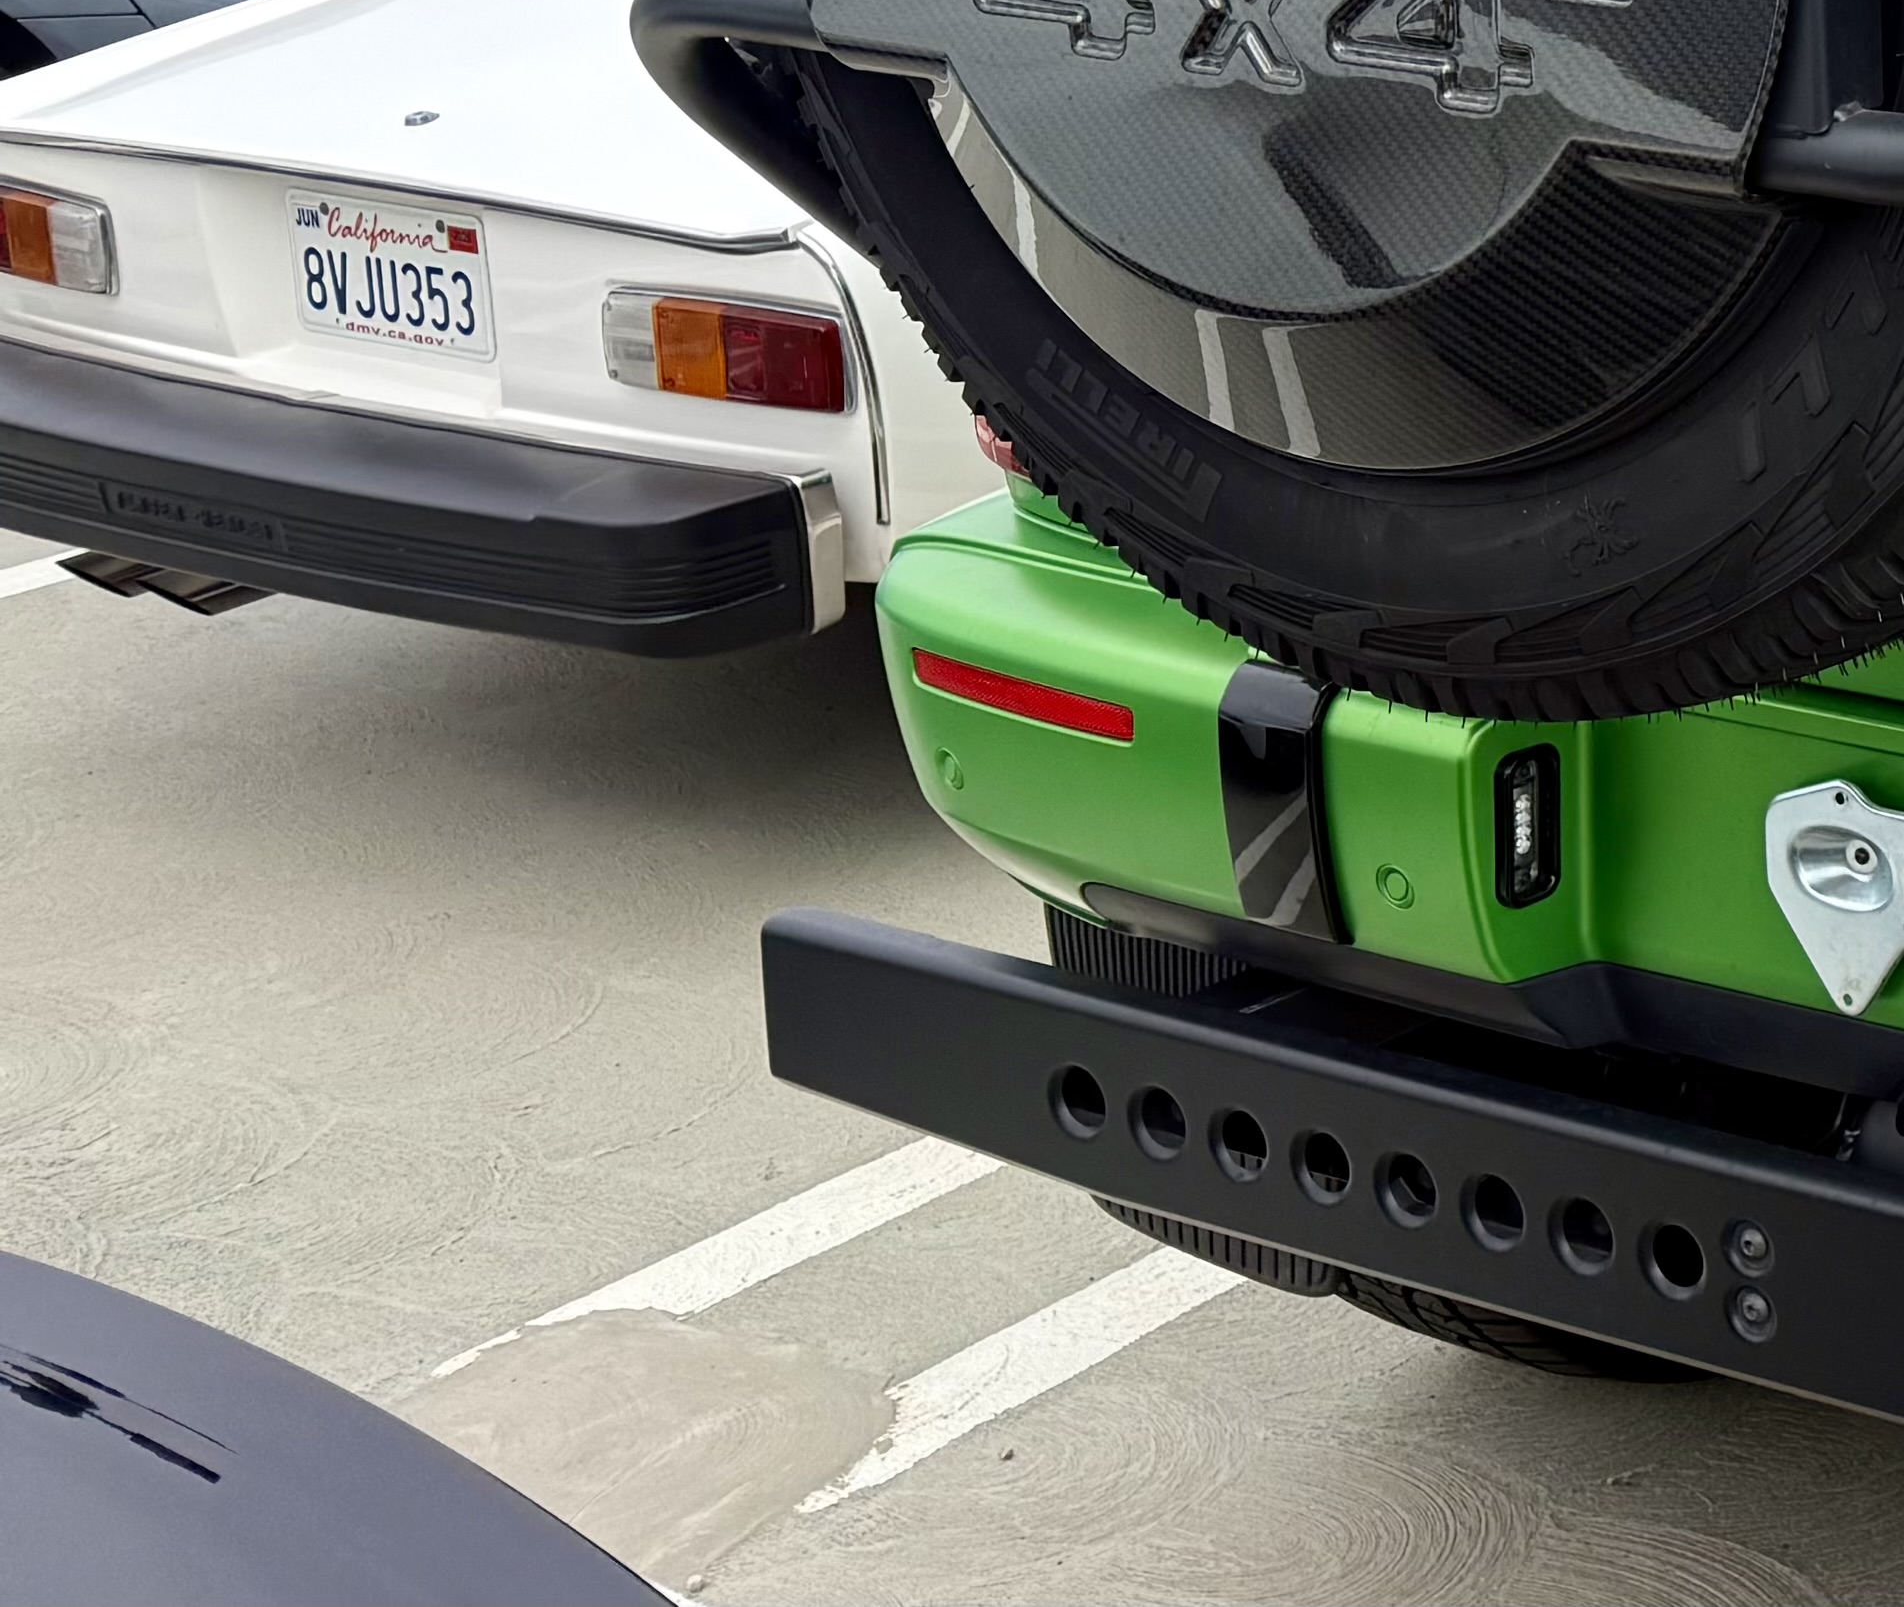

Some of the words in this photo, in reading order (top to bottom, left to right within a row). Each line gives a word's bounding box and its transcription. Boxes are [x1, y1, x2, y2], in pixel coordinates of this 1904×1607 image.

[295, 207, 320, 229] JUN
[326, 206, 448, 253] California
[303, 246, 476, 336] 8VJU353
[345, 321, 445, 347] dmv.ca.gov
[1025, 336, 1225, 525] PIRELLI
